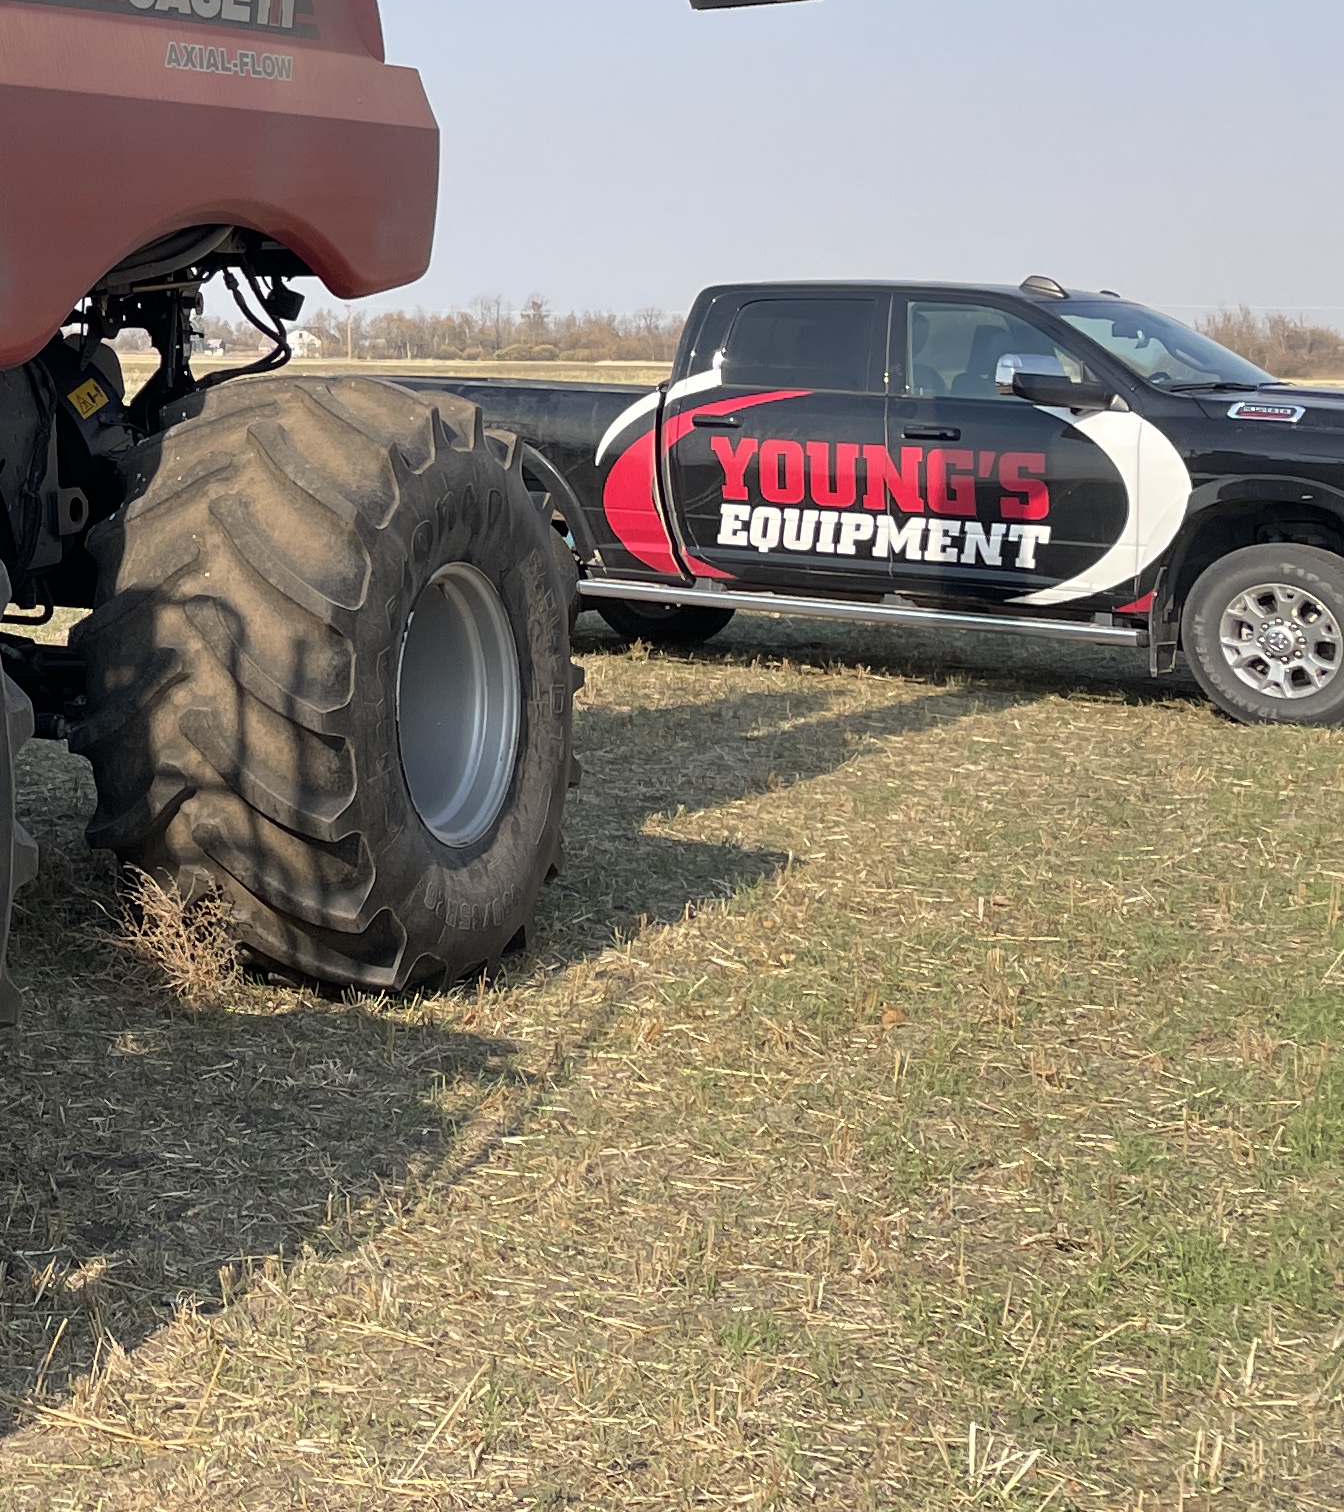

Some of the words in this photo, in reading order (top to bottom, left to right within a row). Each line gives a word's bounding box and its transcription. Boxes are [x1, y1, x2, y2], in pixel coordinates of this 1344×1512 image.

[165, 41, 293, 81] AXIAL-FLOW
[711, 435, 1051, 521] YOUNG'S
[716, 502, 1052, 569] EQUIPMENT
